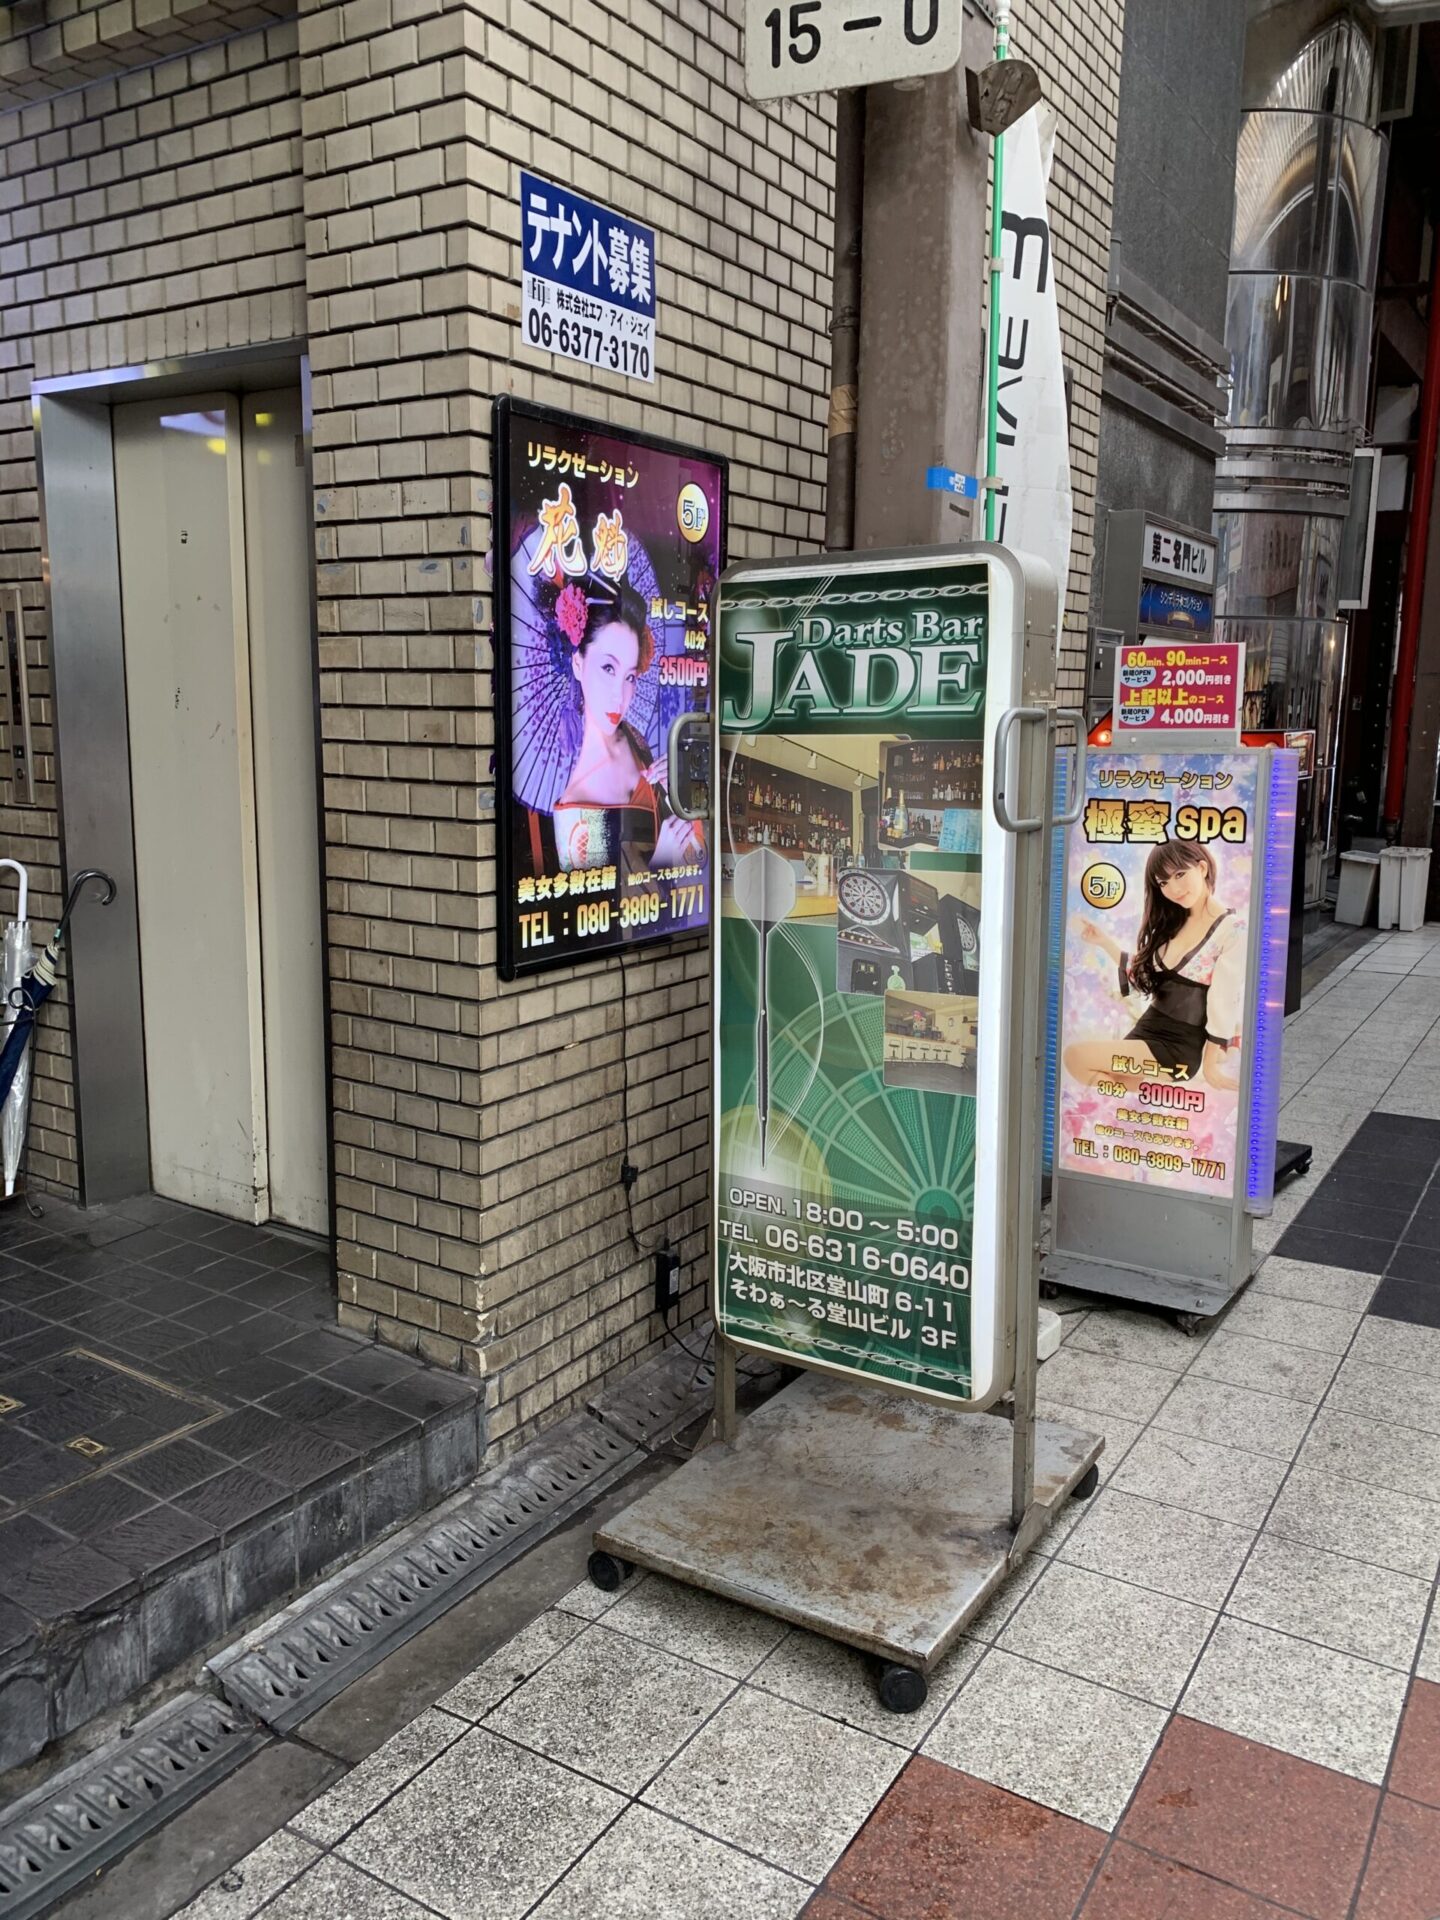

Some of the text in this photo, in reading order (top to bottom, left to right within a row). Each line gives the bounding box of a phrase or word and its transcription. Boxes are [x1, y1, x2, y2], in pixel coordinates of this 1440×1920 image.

[527, 193, 651, 305] テナント募集
[556, 287, 650, 340] 株式会社エフ・アイ・ジェイ
[528, 308, 650, 378] 06-6377-3170
[527, 441, 640, 488] リラクゼーション
[681, 500, 706, 532] 5F
[1151, 531, 1207, 575] 第二名門ビル
[684, 630, 707, 650] 40分
[798, 610, 983, 648] Darts Bar
[660, 656, 708, 687] 3500円
[721, 630, 982, 730] JADE
[1162, 669, 1232, 687] 2,000円引き
[1124, 688, 1225, 706] 上記以上のコース
[1160, 708, 1230, 725] 4,000円引き
[1099, 769, 1233, 791] リラクゼーション
[1175, 804, 1247, 844] spa
[517, 865, 617, 904] 美女多数在籍
[1088, 876, 1120, 900] 5F
[577, 884, 704, 937] 080-3809-1771
[1111, 1055, 1190, 1081] 試しコース
[1097, 1080, 1205, 1112] 30分 3000円
[1116, 1108, 1189, 1131] 美女多数在籍
[1113, 1145, 1226, 1180] 080-3809-1771
[729, 1188, 786, 1216] OPEN.
[792, 1198, 863, 1232] 18:00
[896, 1218, 959, 1250] 5:00
[719, 1219, 969, 1290] TEL. 06-6316-0640
[729, 1251, 889, 1309] 大阪市北区堂山町
[895, 1291, 954, 1323] 6-11
[920, 1326, 958, 1350] 3F
